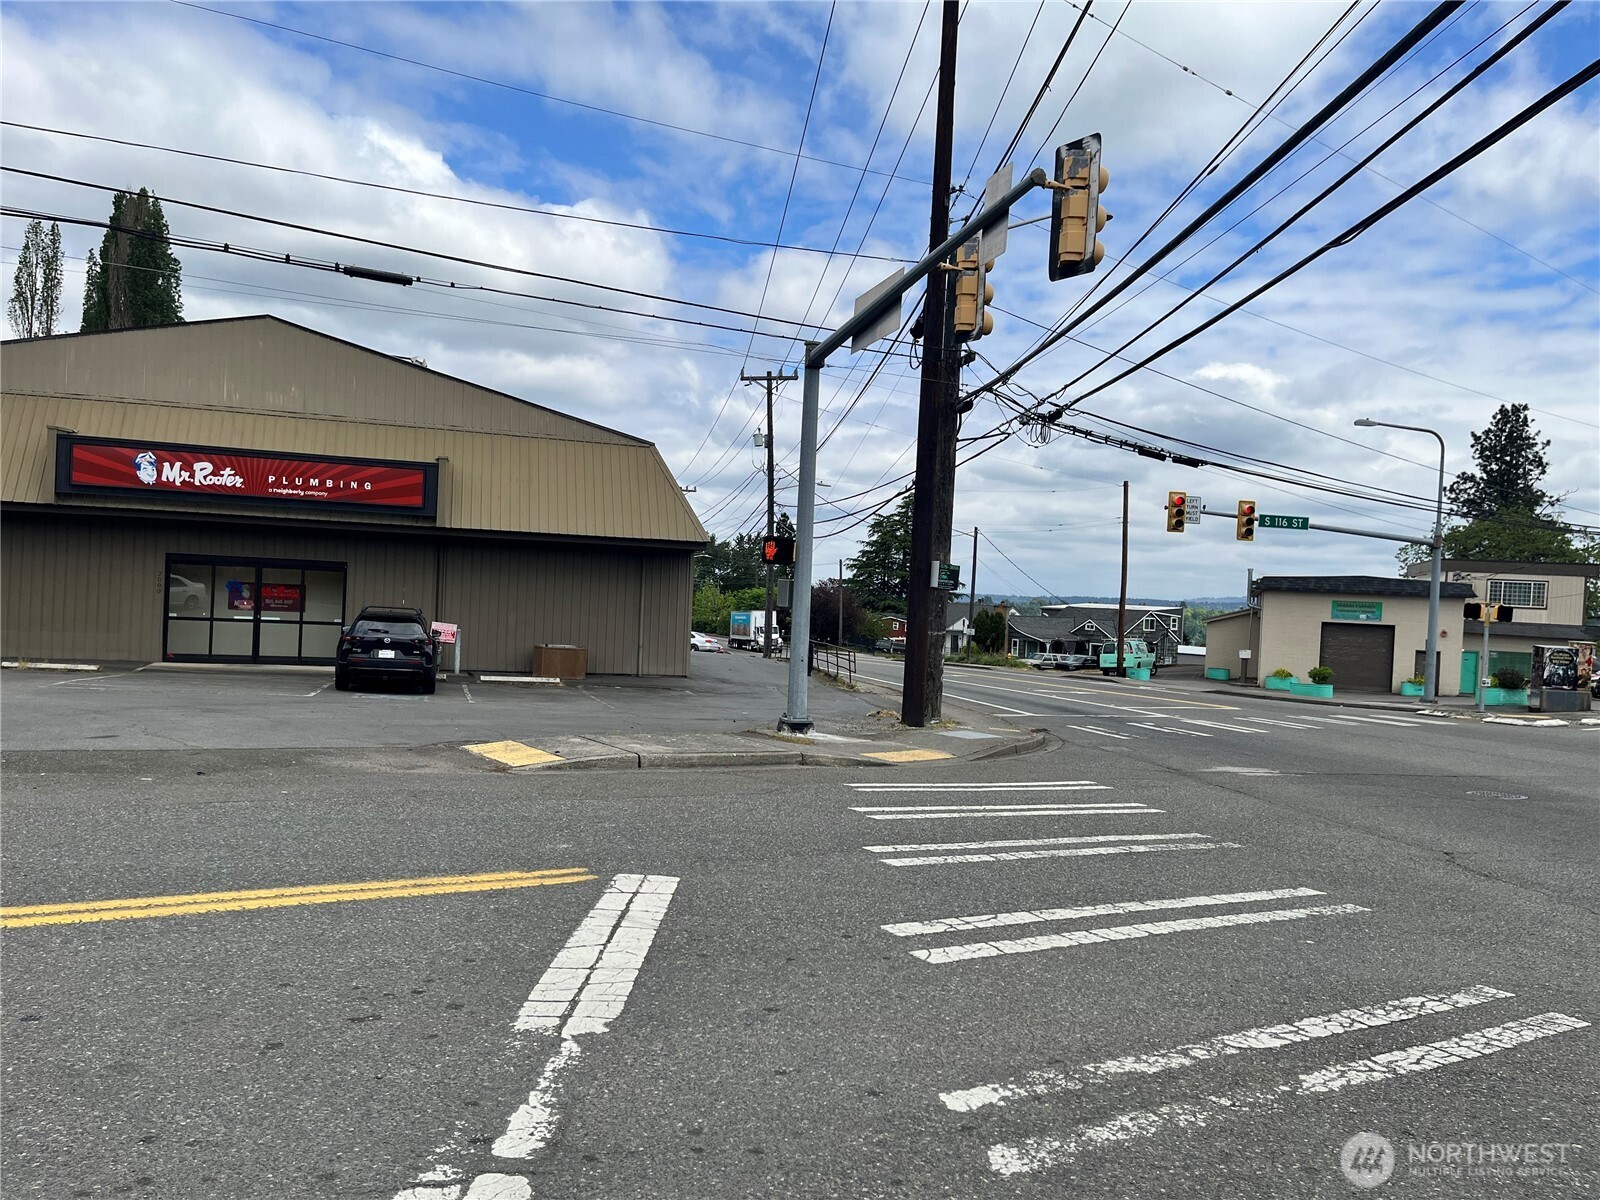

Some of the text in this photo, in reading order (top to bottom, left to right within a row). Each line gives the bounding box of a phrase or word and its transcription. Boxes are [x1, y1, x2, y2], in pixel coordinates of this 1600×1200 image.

[193, 462, 243, 488] Rooter
[268, 475, 372, 490] PLUMBING
[273, 487, 304, 496] neighborly
[1264, 517, 1304, 528] S 116 ST
